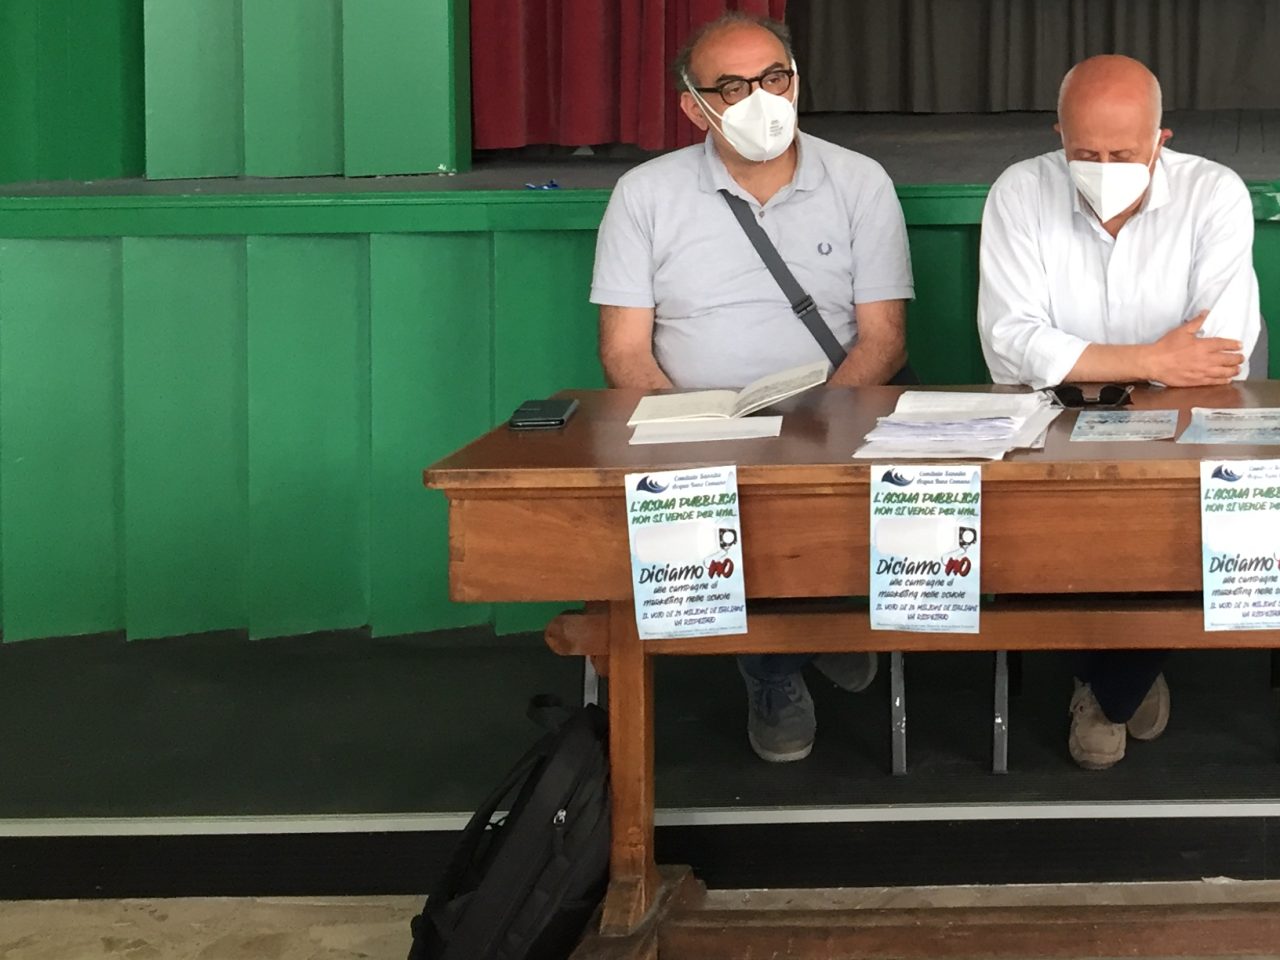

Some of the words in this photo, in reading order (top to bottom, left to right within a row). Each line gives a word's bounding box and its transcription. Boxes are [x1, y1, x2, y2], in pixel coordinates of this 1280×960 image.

[630, 498, 676, 512] L'ACQUA
[679, 493, 736, 508] PUBBLICA
[873, 492, 919, 504] L'ACQUA
[922, 492, 980, 504] PUBBLICA
[874, 507, 893, 515] NON
[895, 507, 906, 515] SI
[907, 507, 935, 515] VENDE
[938, 507, 955, 515] PER
[1226, 502, 1237, 511] SI
[1238, 502, 1267, 511] VENDE
[632, 515, 651, 524] NON
[653, 513, 664, 522] SI
[665, 511, 694, 521] VENDE
[697, 510, 714, 518] PER
[709, 558, 734, 579] NO
[945, 557, 971, 577] NO
